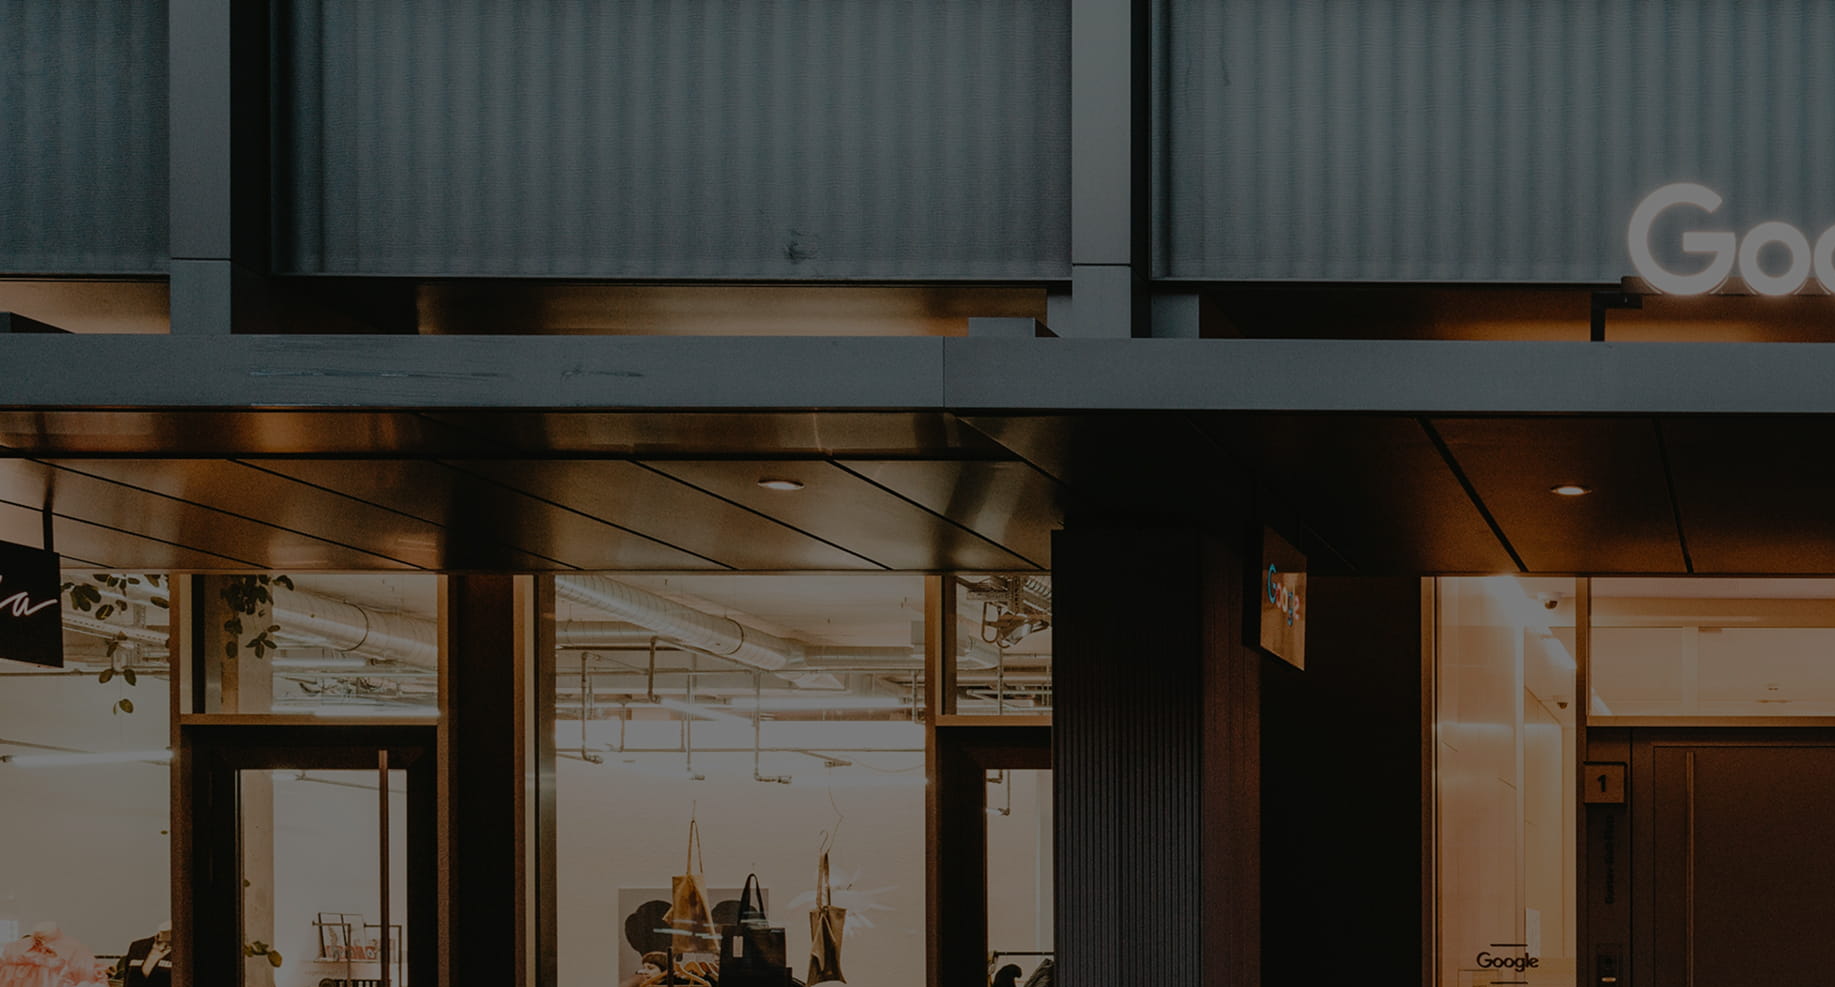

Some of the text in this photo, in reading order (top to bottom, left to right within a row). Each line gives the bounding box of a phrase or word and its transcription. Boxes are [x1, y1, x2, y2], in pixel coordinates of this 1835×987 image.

[1267, 562, 1300, 627] Google
[1597, 774, 1607, 793] 1
[1476, 951, 1539, 973] Google
